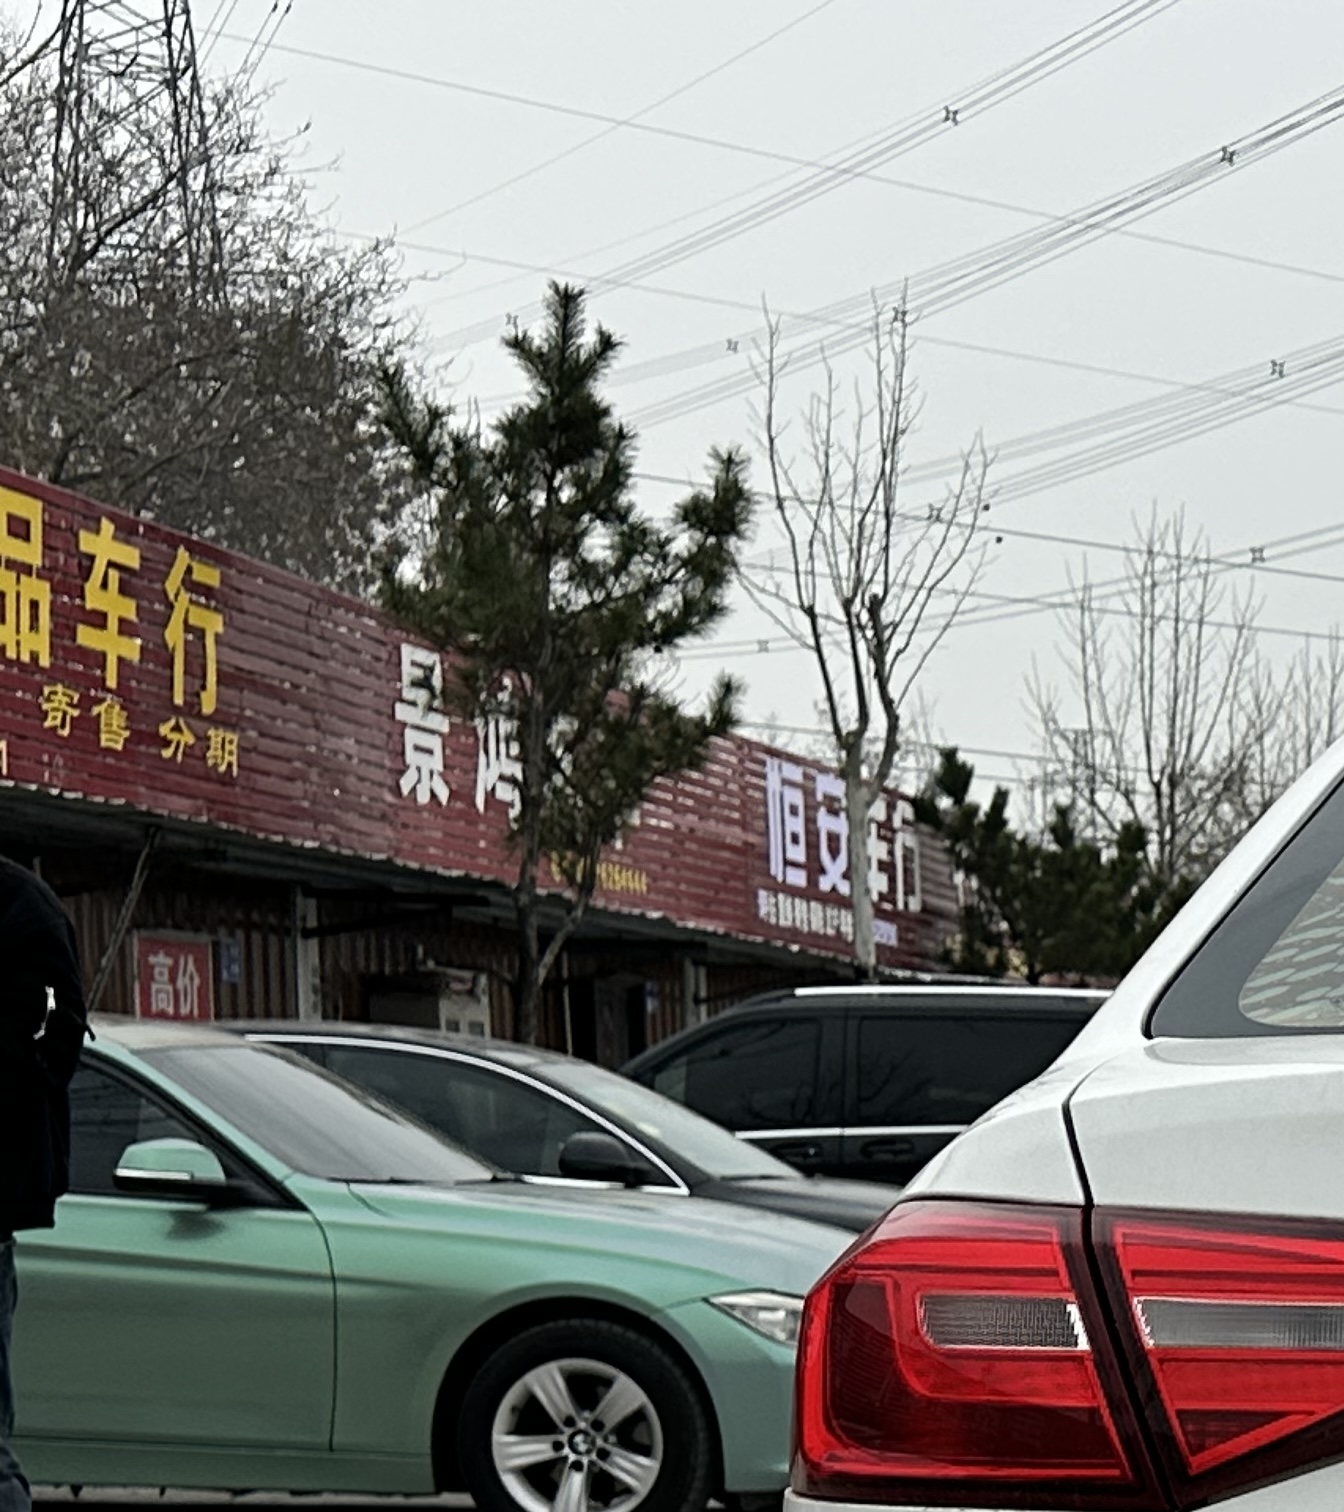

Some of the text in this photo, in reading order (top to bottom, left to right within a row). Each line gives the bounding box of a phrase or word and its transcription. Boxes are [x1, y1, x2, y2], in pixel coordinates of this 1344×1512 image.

[40, 683, 239, 778] 寄售 分期
[147, 949, 200, 1019] 高价
